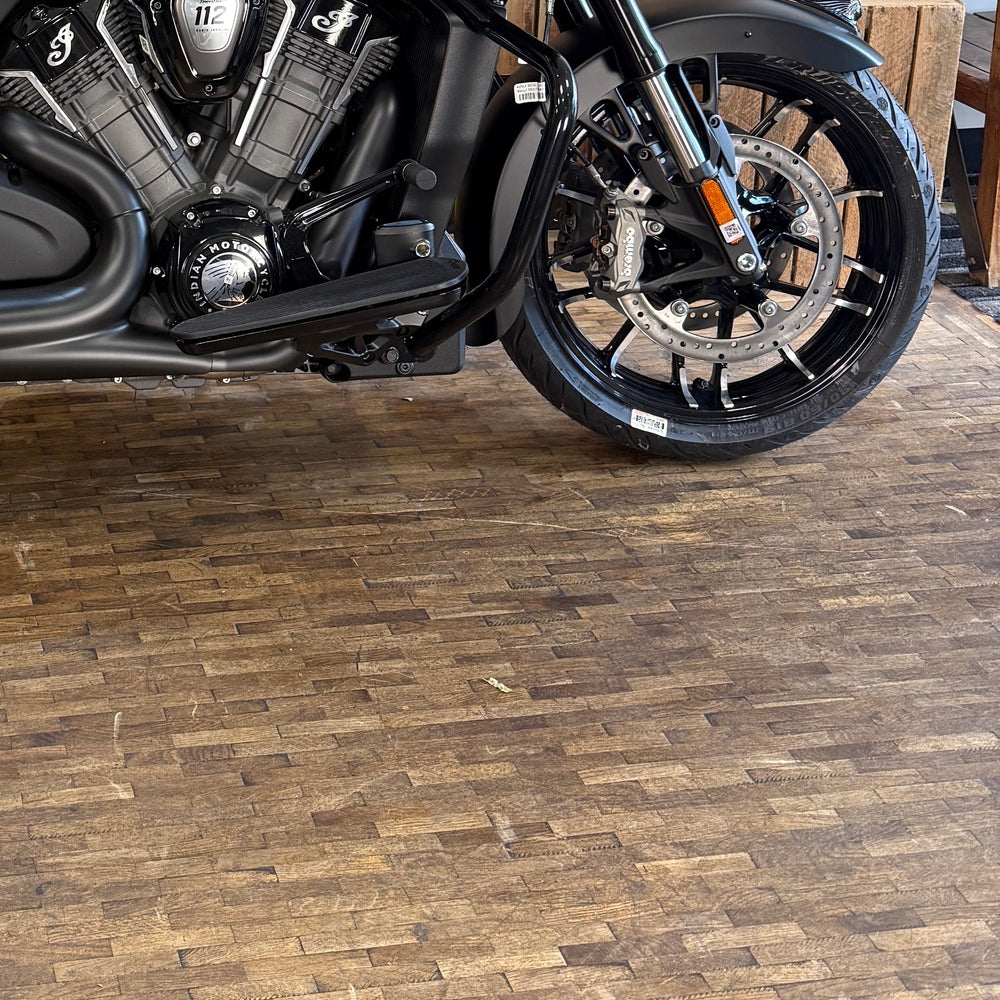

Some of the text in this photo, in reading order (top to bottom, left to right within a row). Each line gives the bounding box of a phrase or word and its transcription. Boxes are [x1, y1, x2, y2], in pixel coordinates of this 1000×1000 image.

[195, 5, 226, 25] 112
[621, 227, 635, 277] brembo
[190, 254, 207, 307] INDIAN
